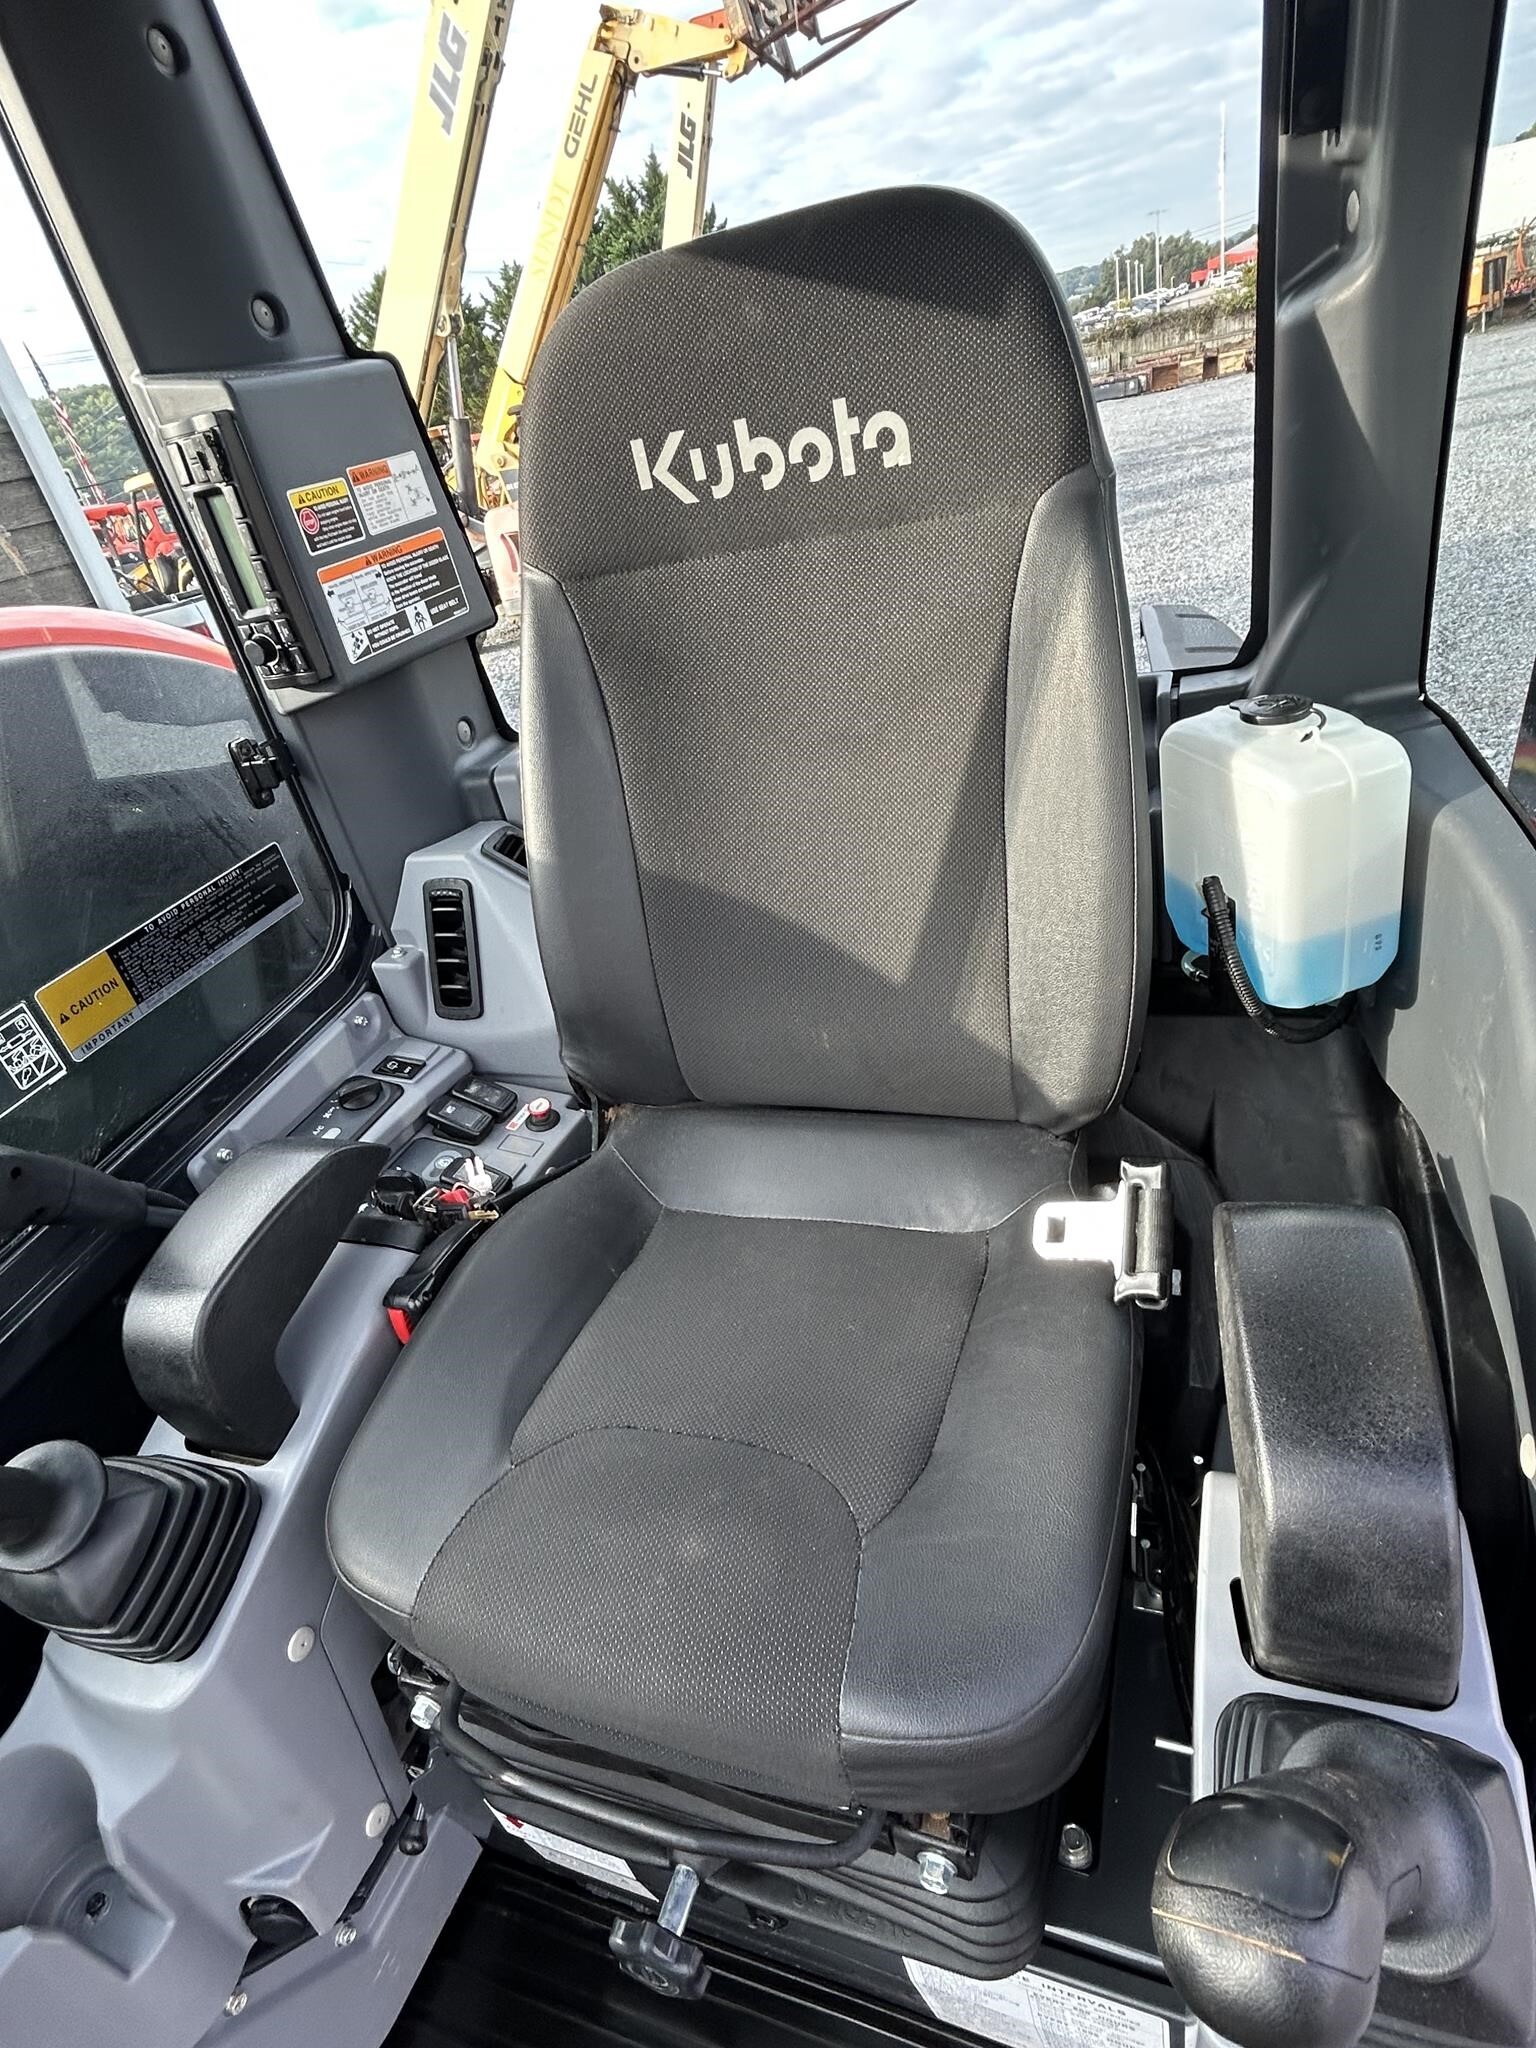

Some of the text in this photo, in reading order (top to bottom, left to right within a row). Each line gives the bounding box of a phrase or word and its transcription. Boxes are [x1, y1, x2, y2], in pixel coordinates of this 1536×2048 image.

[429, 11, 467, 136] JLG
[564, 74, 598, 158] GEHL
[677, 111, 696, 180] JLG
[630, 397, 912, 504] Kubota
[306, 485, 339, 500] CAUTION
[372, 545, 402, 563] WARNING
[144, 924, 155, 934] TO
[157, 908, 179, 925] AVOID
[181, 886, 217, 910] PERSONAL
[70, 977, 119, 1016] CAUTION
[81, 1011, 135, 1054] IMPORTANT
[1042, 1983, 1126, 2016] INTERVALS
